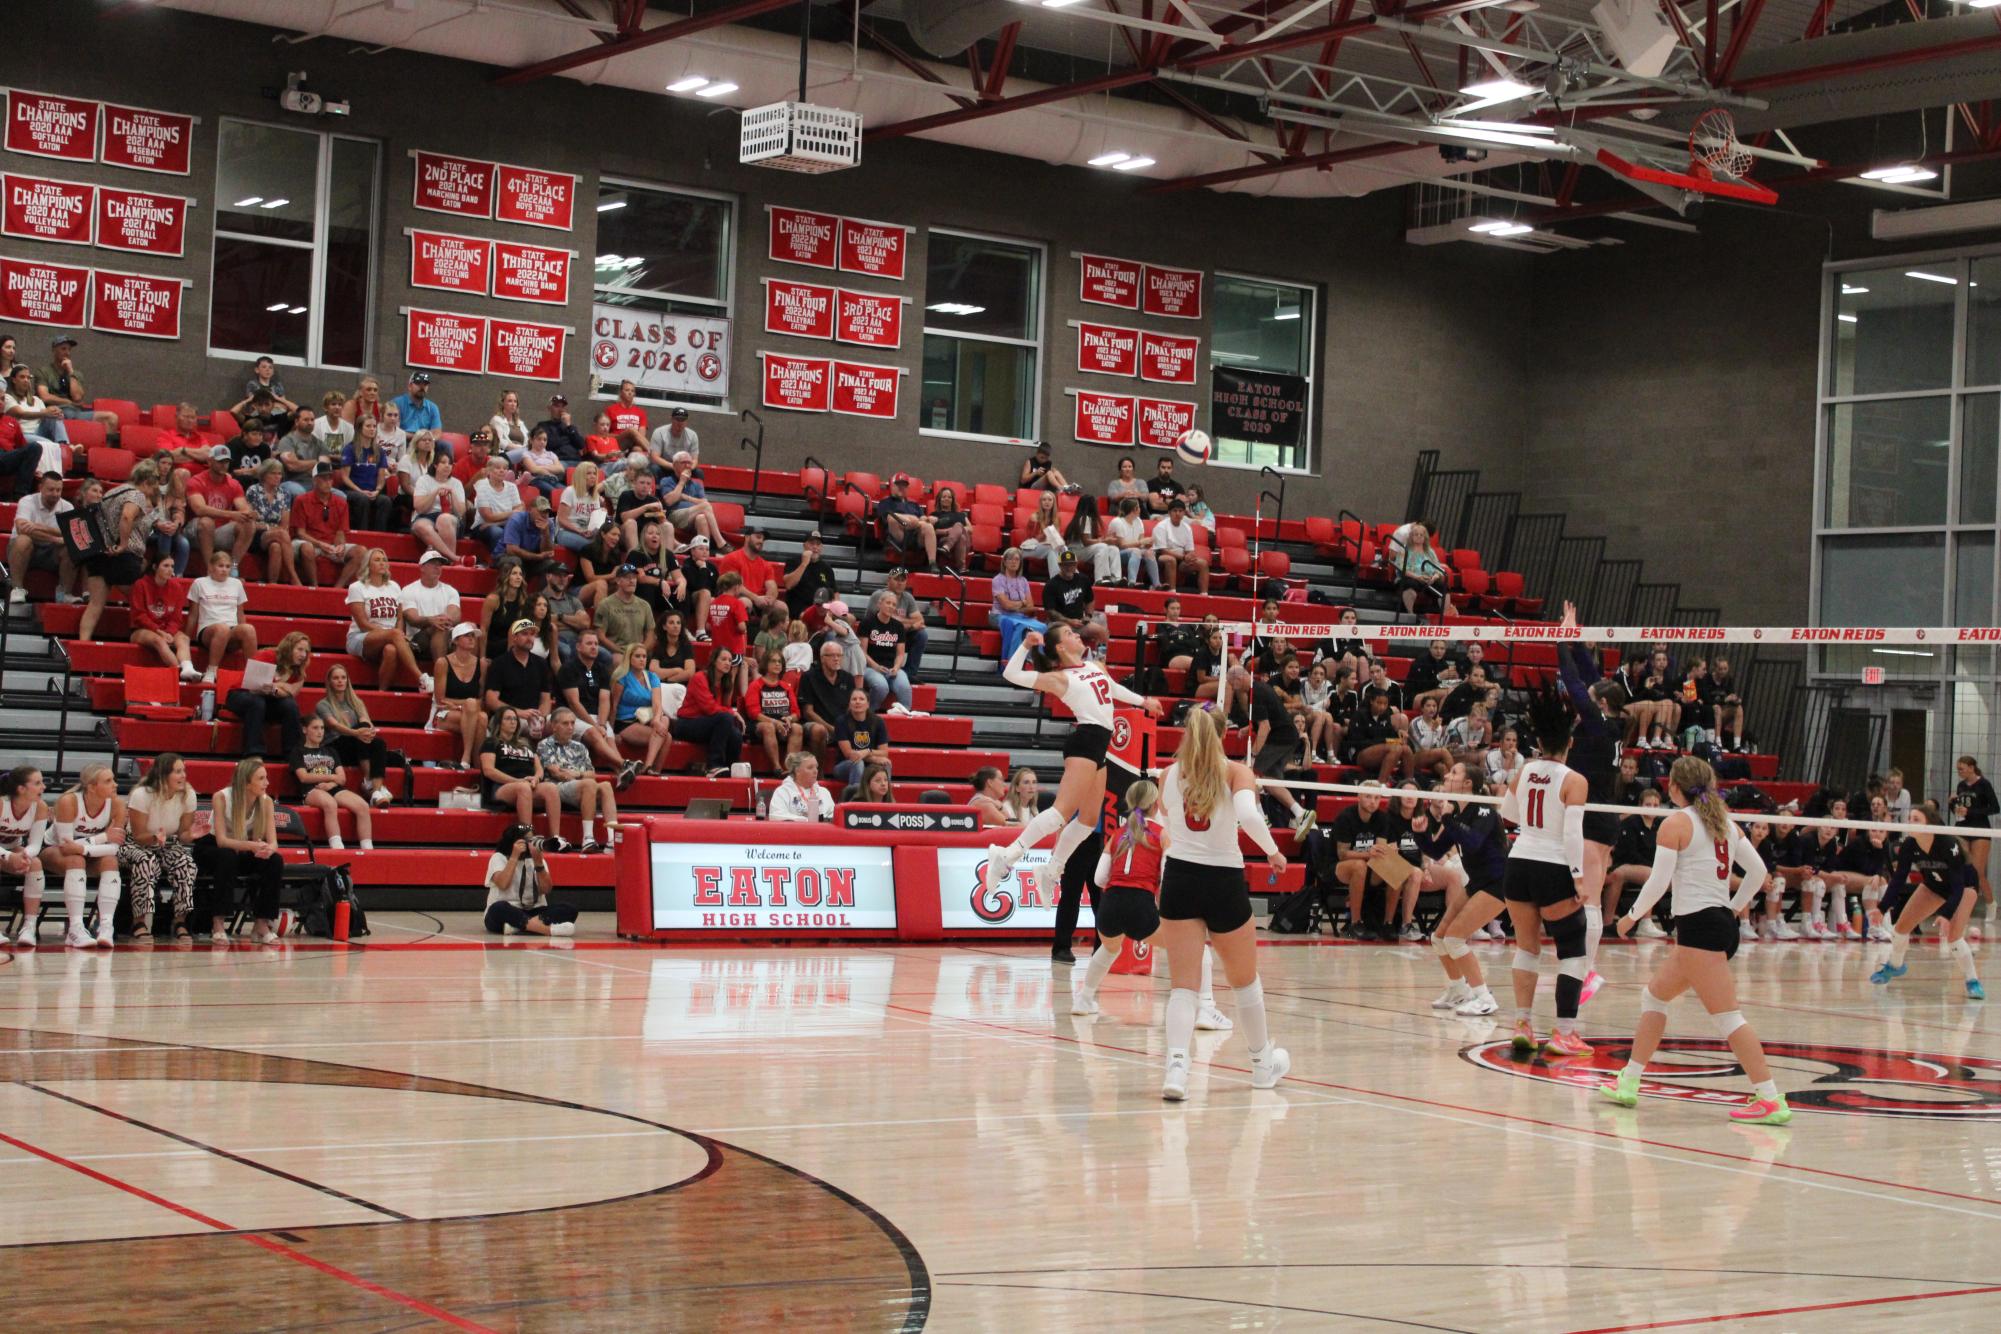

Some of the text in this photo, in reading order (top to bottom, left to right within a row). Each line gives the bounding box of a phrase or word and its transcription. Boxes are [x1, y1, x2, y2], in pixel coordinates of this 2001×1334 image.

[39, 100, 67, 112] STATE
[18, 103, 87, 130] CHAMPIONS
[133, 115, 160, 126] STATE
[30, 122, 72, 136] 2020 AAA
[113, 117, 179, 144] CHAMPIONS
[32, 132, 69, 145] SOFTBALL
[126, 136, 165, 150] 2021 AAA
[39, 142, 60, 152] EATON
[127, 146, 163, 158] BASEBALL
[134, 156, 155, 165] EATON
[443, 162, 467, 172] STATE
[425, 164, 485, 190] 2ND PLACE
[526, 174, 549, 184] STATE
[35, 184, 62, 196] STATE
[439, 182, 468, 194] 2021 AA
[508, 178, 565, 201] 4TH PLACE
[14, 187, 82, 214] CHAMPIONS
[127, 197, 154, 208] STATE
[443, 199, 461, 209] EATON
[26, 206, 68, 219] 2020 AAA
[108, 200, 174, 226] CHAMPIONS
[516, 201, 554, 214] BOYS TRACK
[24, 215, 70, 228] VOLLEYBALL
[526, 211, 544, 220] EATON
[36, 226, 56, 235] EATON
[123, 218, 156, 231] 2021 AA
[779, 218, 830, 241] CHAMPIONS
[122, 228, 156, 240] FOOTBALL
[128, 238, 148, 246] EATON
[441, 239, 464, 250] STATE
[848, 230, 898, 252] CHAMPIONS
[422, 242, 481, 266] CHAMPIONS
[522, 250, 545, 260] STATE
[502, 254, 563, 277] THIRD PLACE
[30, 268, 57, 280] STATE
[434, 267, 469, 279] WRESTLING
[1087, 265, 1136, 285] FINAL FOUR
[9, 272, 77, 298] RUNNER UP
[124, 279, 150, 290] STATE
[442, 277, 459, 286] EATON
[1151, 276, 1195, 294] CHAMPIONS
[22, 290, 61, 304] 2021 AAA
[104, 283, 170, 309] FINAL FOUR
[522, 287, 540, 296] EATON
[21, 300, 62, 312] WRESTLING
[117, 301, 155, 314] 2021 AAA
[774, 290, 827, 314] FINAL FOUR
[30, 310, 50, 319] EATON
[118, 310, 153, 322] SOFTBALL
[844, 302, 892, 322] 3RD PLACE
[125, 320, 145, 329] EATON
[436, 318, 459, 328] STATE
[418, 322, 477, 345] CHAMPIONS
[516, 327, 539, 337] STATE
[594, 317, 722, 351] CLASS OF
[498, 330, 556, 353] CHAMPIONS
[1084, 333, 1133, 352] FINAL FOUR
[430, 348, 462, 358] BASEBALL
[1145, 342, 1192, 360] FINAL FOUR
[437, 357, 455, 365] EATON
[509, 356, 540, 367] SOFTBALL
[627, 348, 688, 373] 2026
[515, 364, 533, 373] EATON
[771, 364, 823, 384] CHAMPIONS
[838, 373, 892, 393] FINAL FOUR
[1083, 401, 1128, 420] CHAMPIONS
[1143, 407, 1188, 427] FINAL FOUR
[1266, 625, 1331, 635] EATON REDS
[1380, 626, 1450, 637] EATON REDS
[1504, 628, 1581, 638] EATON REDS
[1640, 628, 1725, 640] EATON REDS
[1791, 629, 1886, 640] EATON REDS
[1958, 629, 2001, 640] EATO
[1865, 668, 1882, 682] EXIT
[900, 816, 923, 828] POSS
[745, 848, 802, 860] Welcome to
[1022, 853, 1047, 863] Home
[1714, 834, 1729, 880] 9
[692, 866, 856, 907] EATON
[703, 913, 851, 926] HIGH SCHOOL
